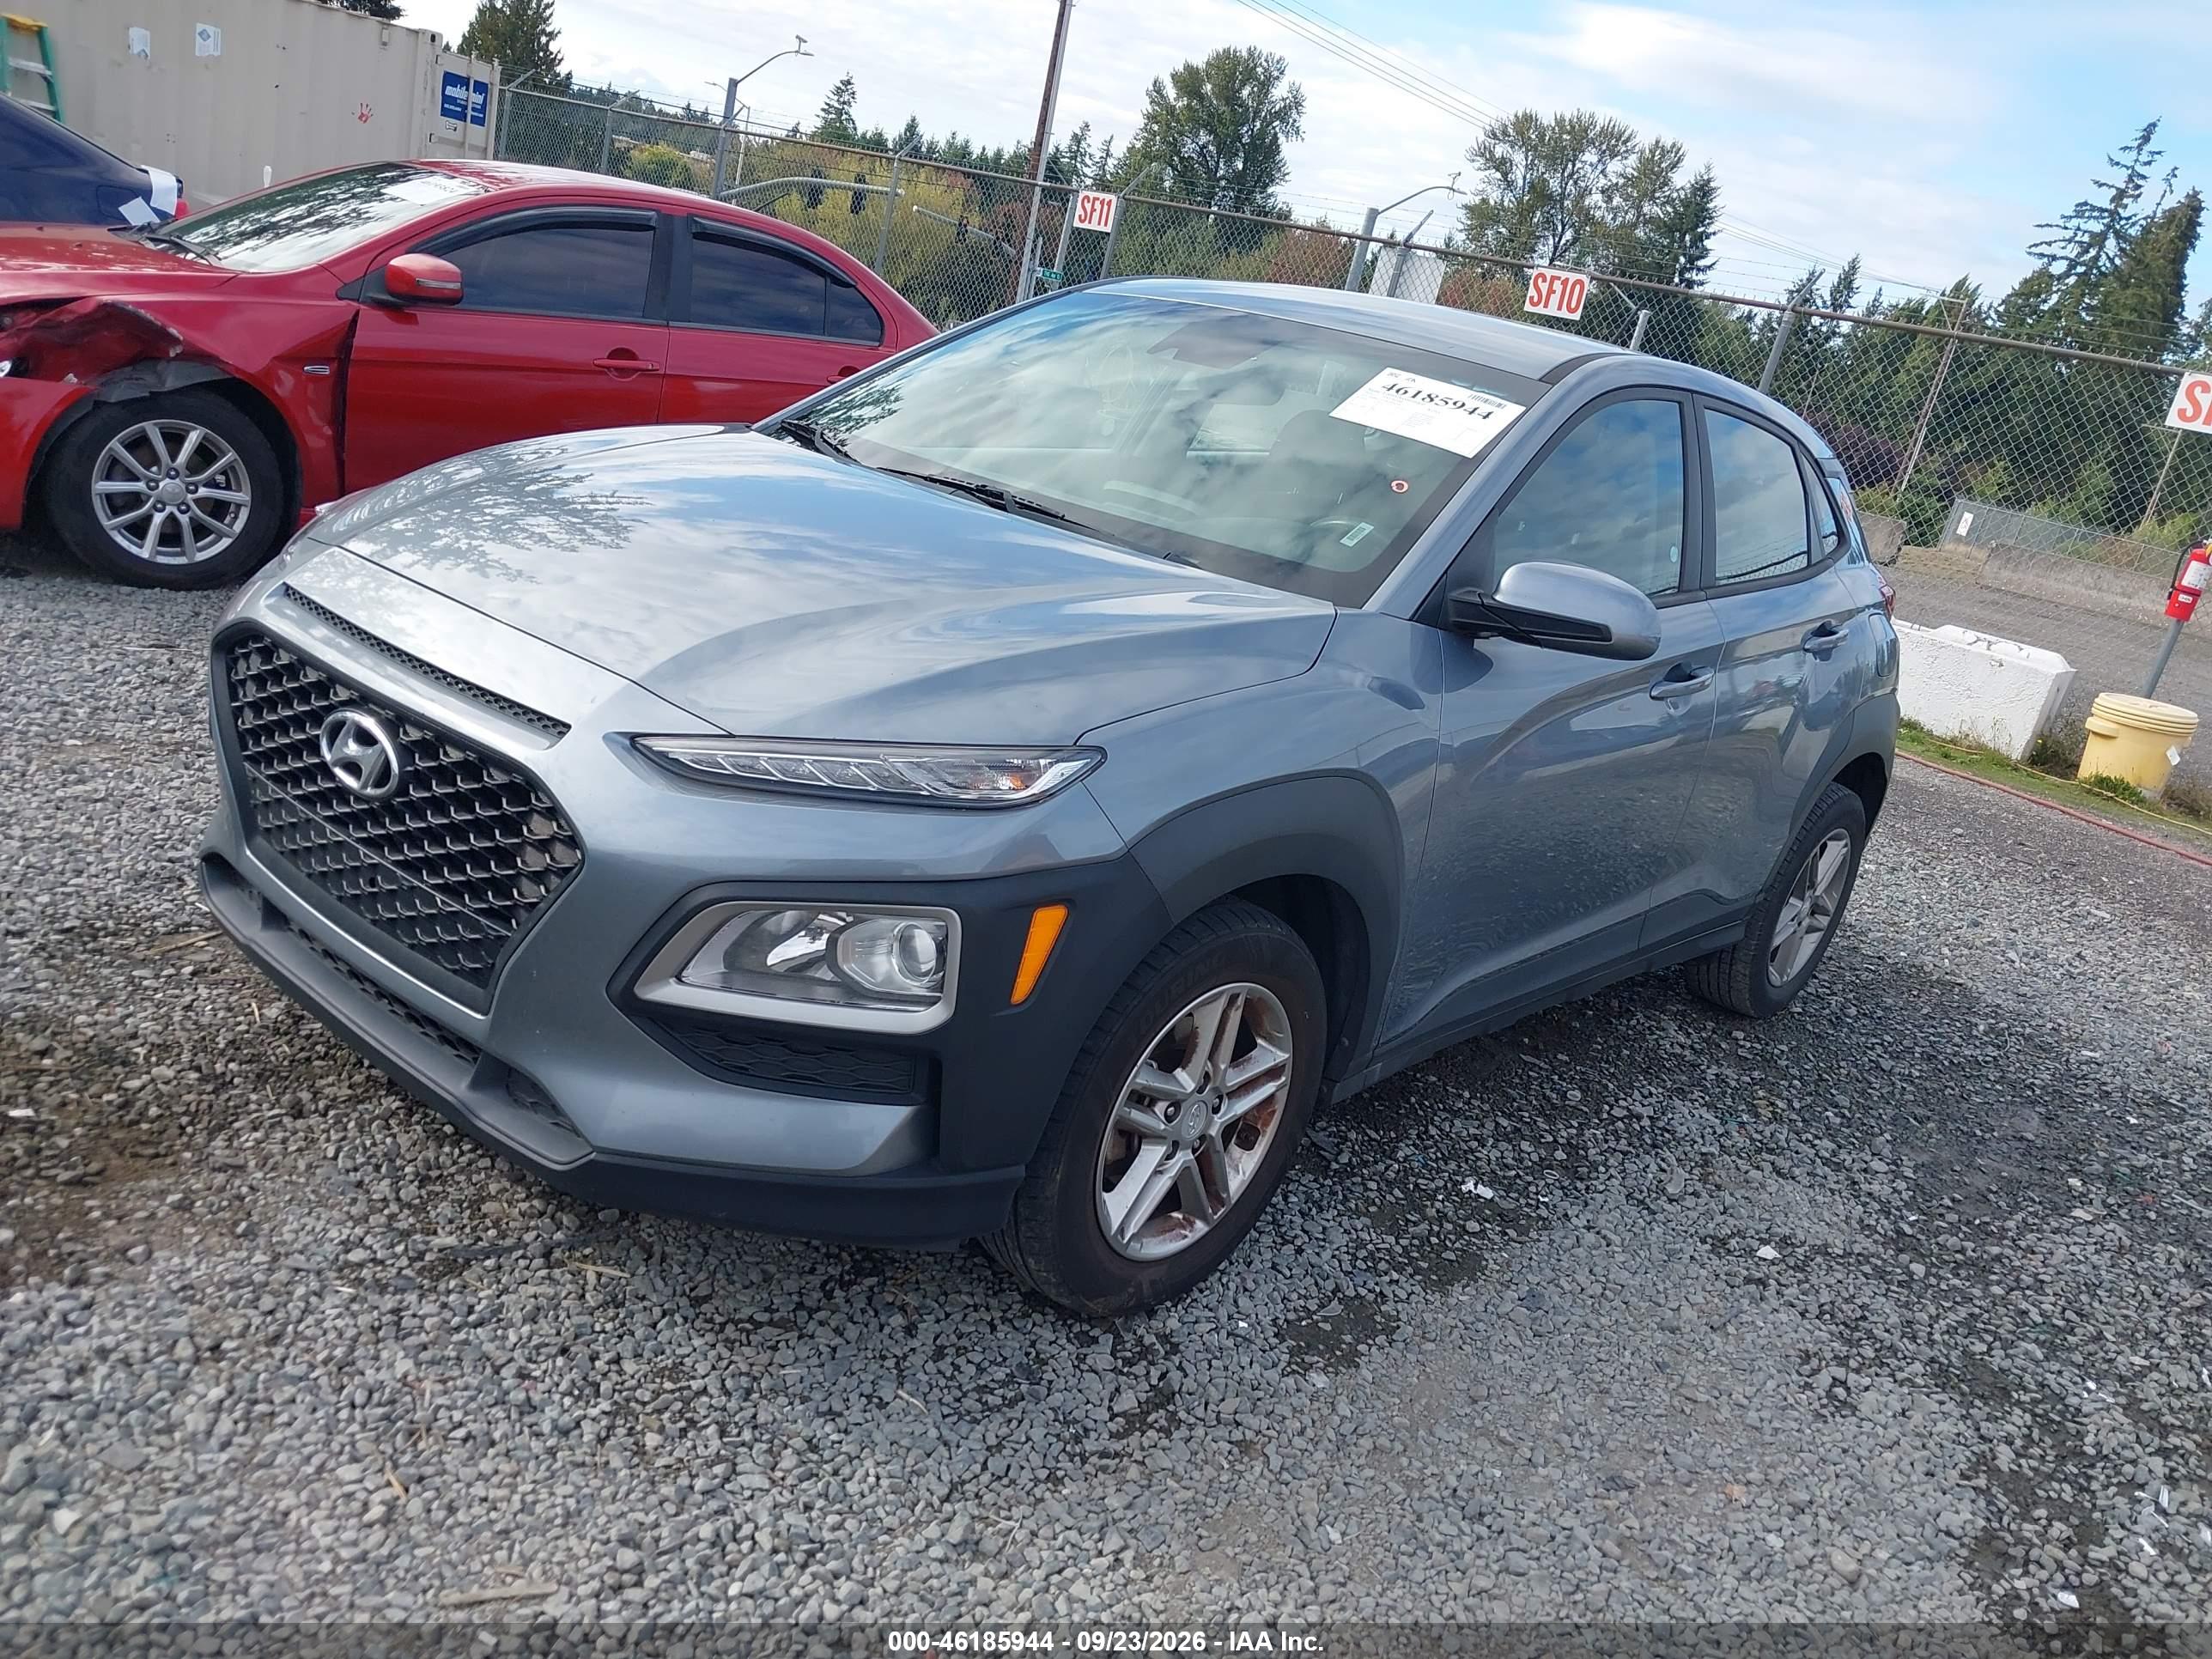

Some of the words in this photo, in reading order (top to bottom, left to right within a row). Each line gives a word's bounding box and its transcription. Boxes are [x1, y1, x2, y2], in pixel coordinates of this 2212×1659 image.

[1078, 195, 1113, 228] SF11
[1528, 272, 1585, 314] SF10
[1381, 382, 1495, 421] 46185944
[2177, 380, 2212, 427] S
